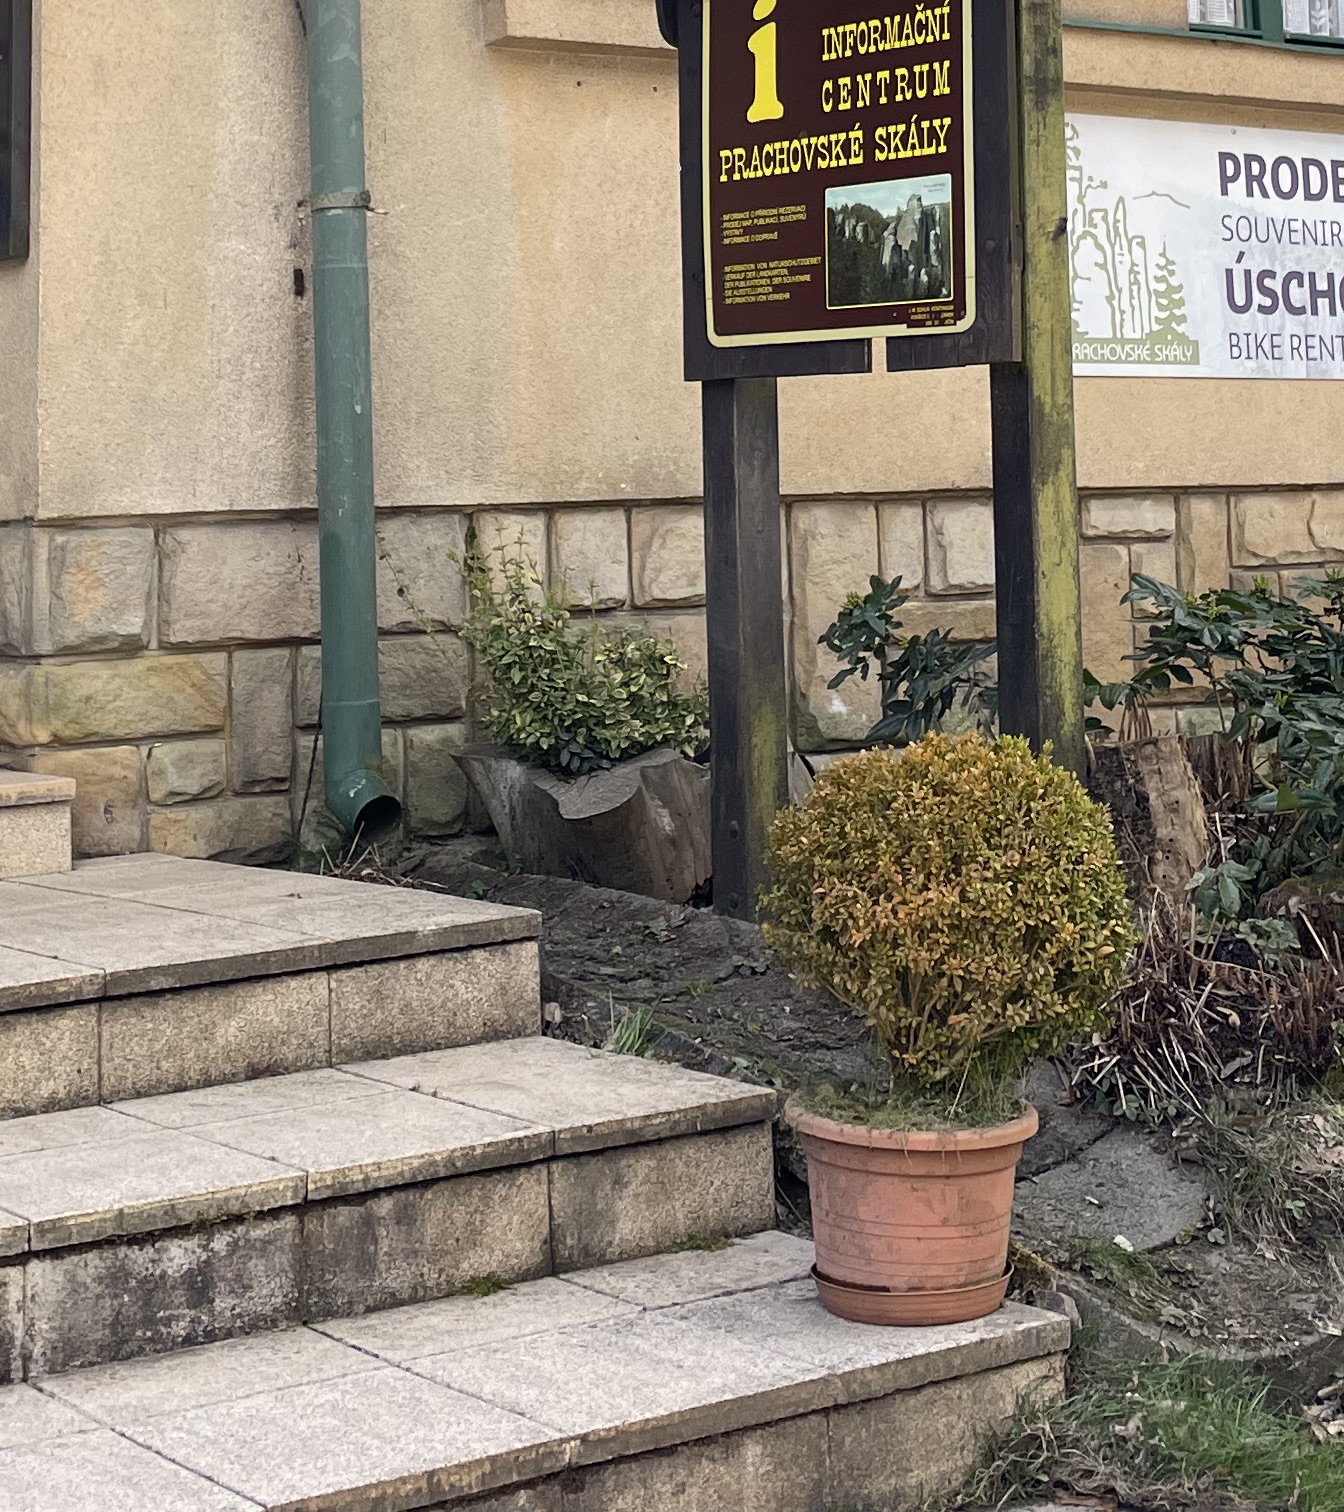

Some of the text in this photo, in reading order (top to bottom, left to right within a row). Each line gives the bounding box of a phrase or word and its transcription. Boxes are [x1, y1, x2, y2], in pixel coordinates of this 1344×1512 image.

[822, 59, 951, 113] CENTRUM
[719, 114, 952, 183] PRACHOVSKÉ SKÁLY
[1221, 215, 1342, 247] SOUVENIR
[1072, 340, 1193, 362] RACHOVSKÉ SKÁLY
[1229, 332, 1284, 361] BIKE
